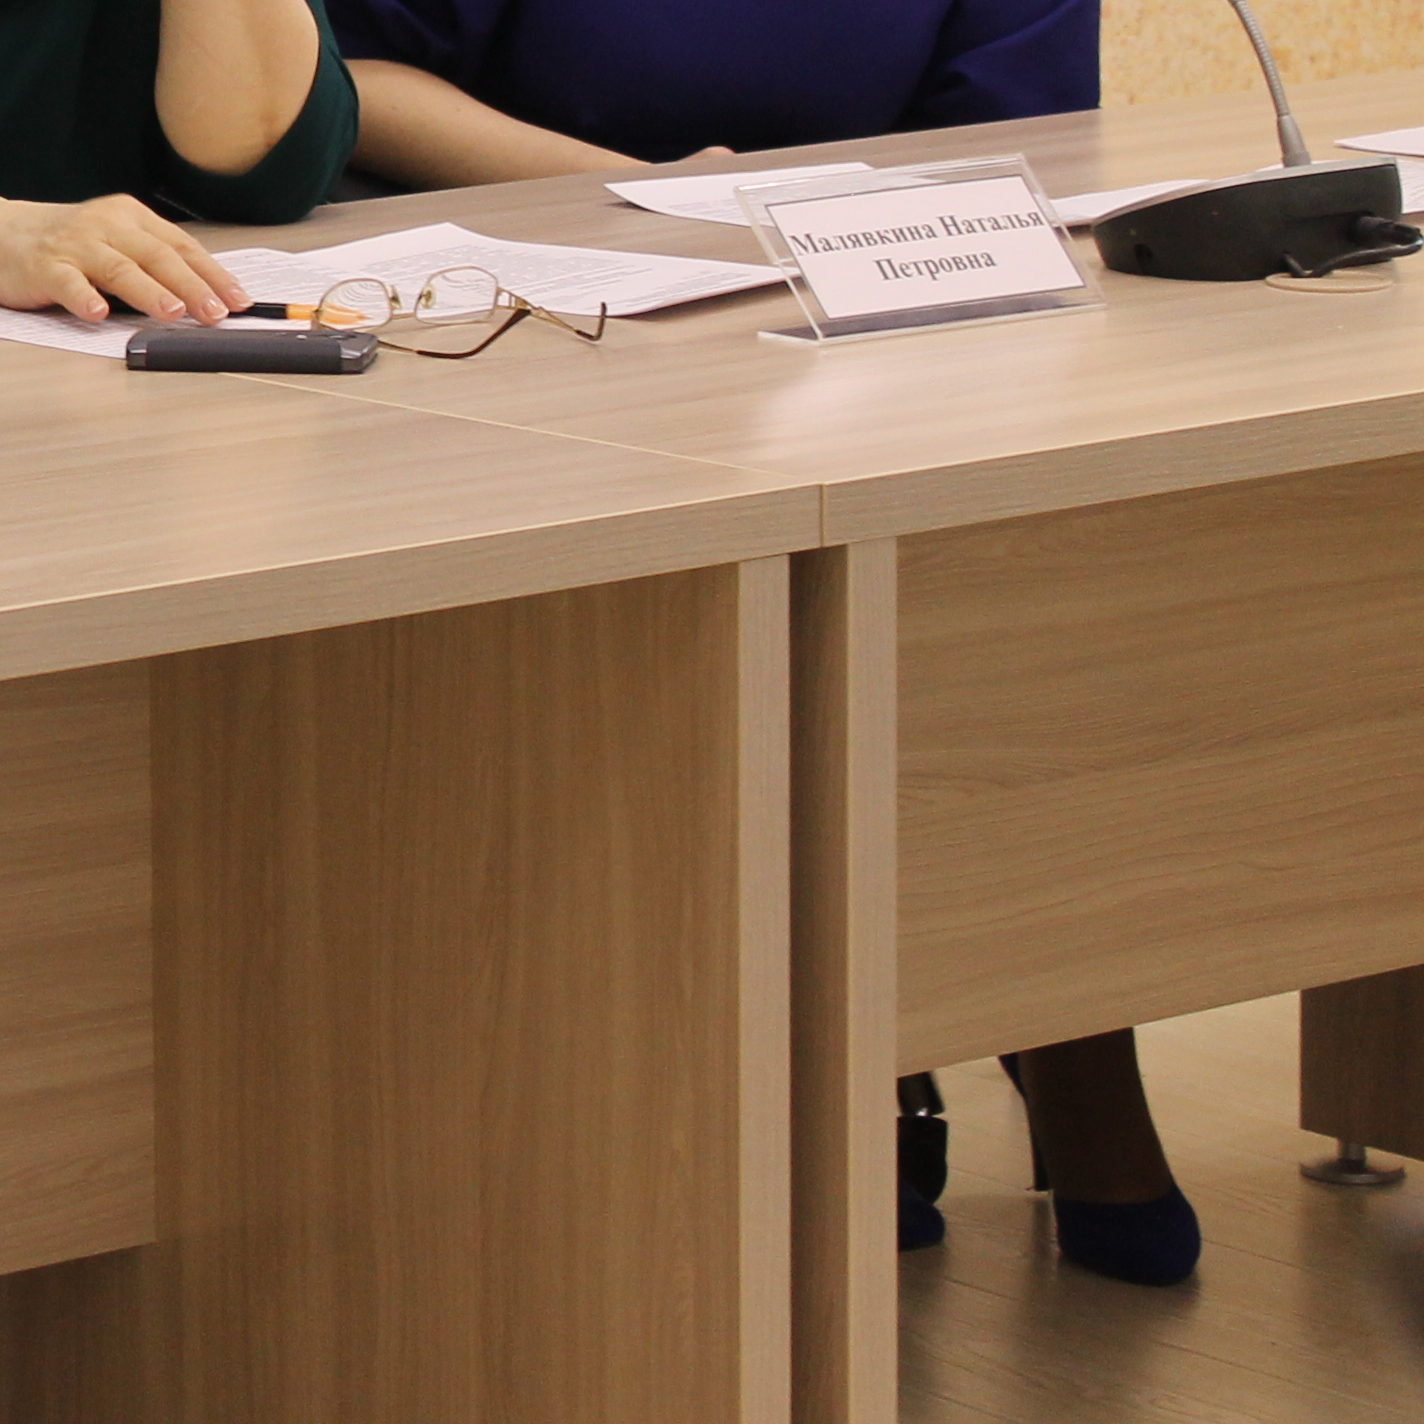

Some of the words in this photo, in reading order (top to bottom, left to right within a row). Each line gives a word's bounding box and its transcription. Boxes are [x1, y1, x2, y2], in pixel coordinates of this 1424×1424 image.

[788, 223, 939, 257] Малявкина
[936, 211, 1046, 237] Наталья
[873, 250, 997, 282] Петровна
